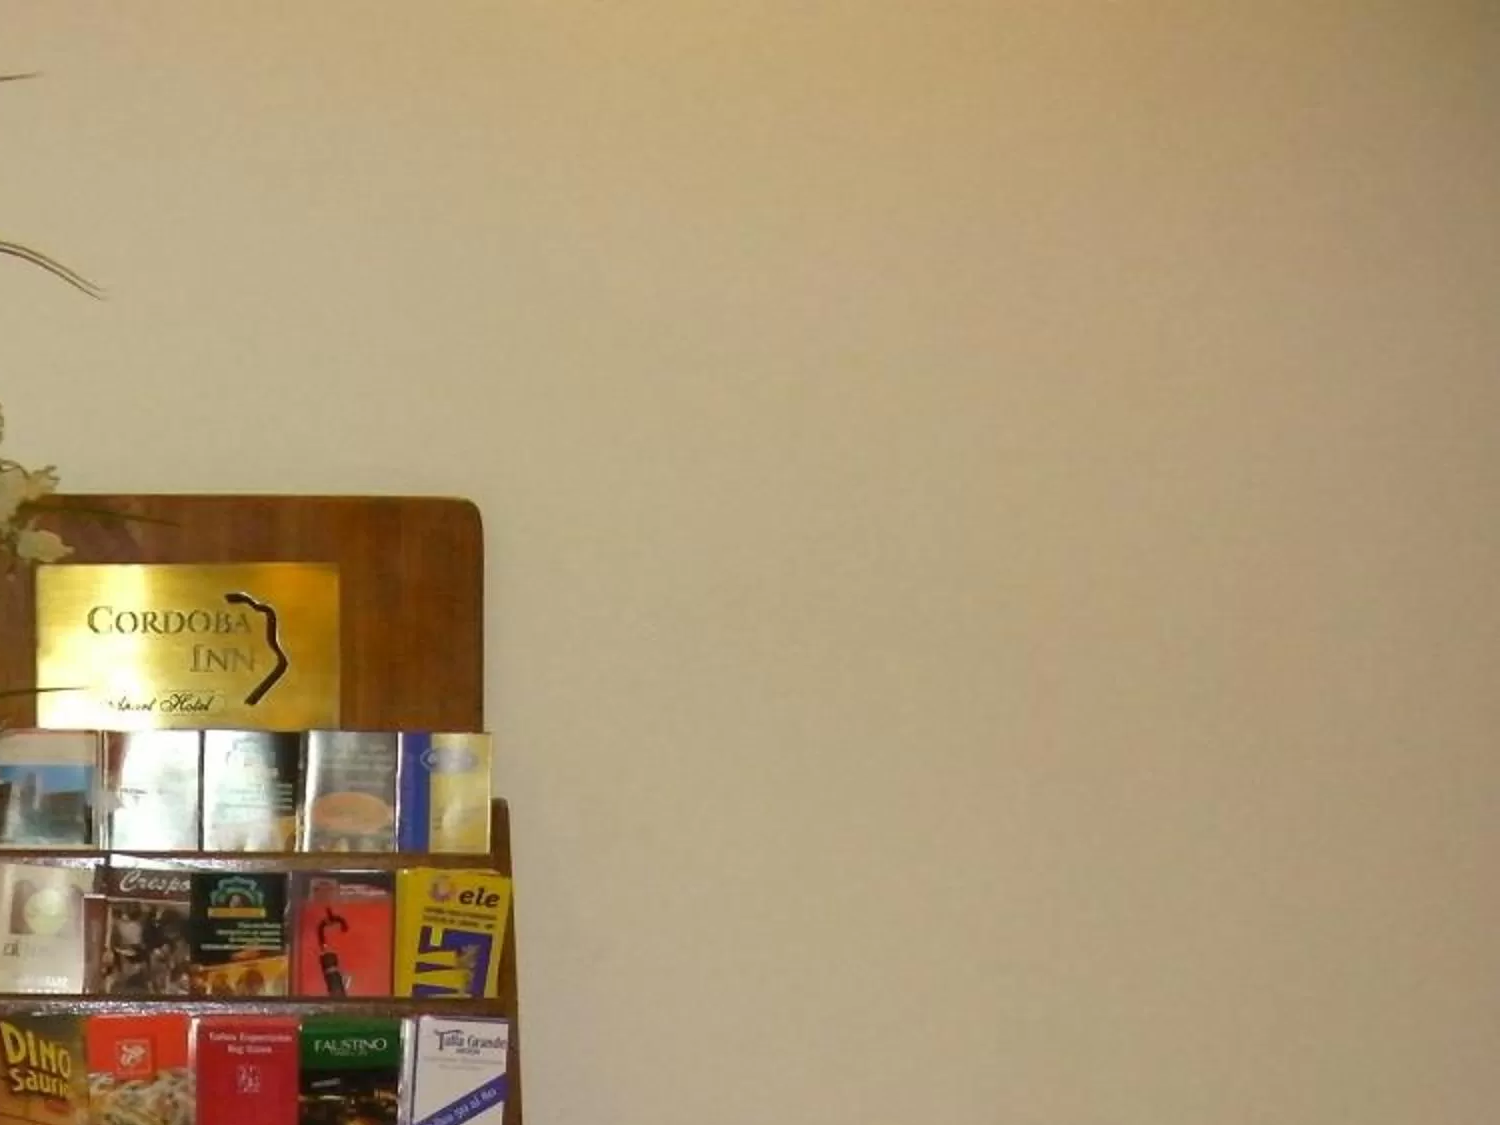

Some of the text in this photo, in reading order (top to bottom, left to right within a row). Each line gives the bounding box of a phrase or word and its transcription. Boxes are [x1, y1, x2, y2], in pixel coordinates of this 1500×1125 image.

[87, 606, 253, 634] CORDOBA
[189, 643, 256, 672] INN
[0, 1020, 72, 1079] DINO
[313, 1037, 388, 1052] FAUSTINO
